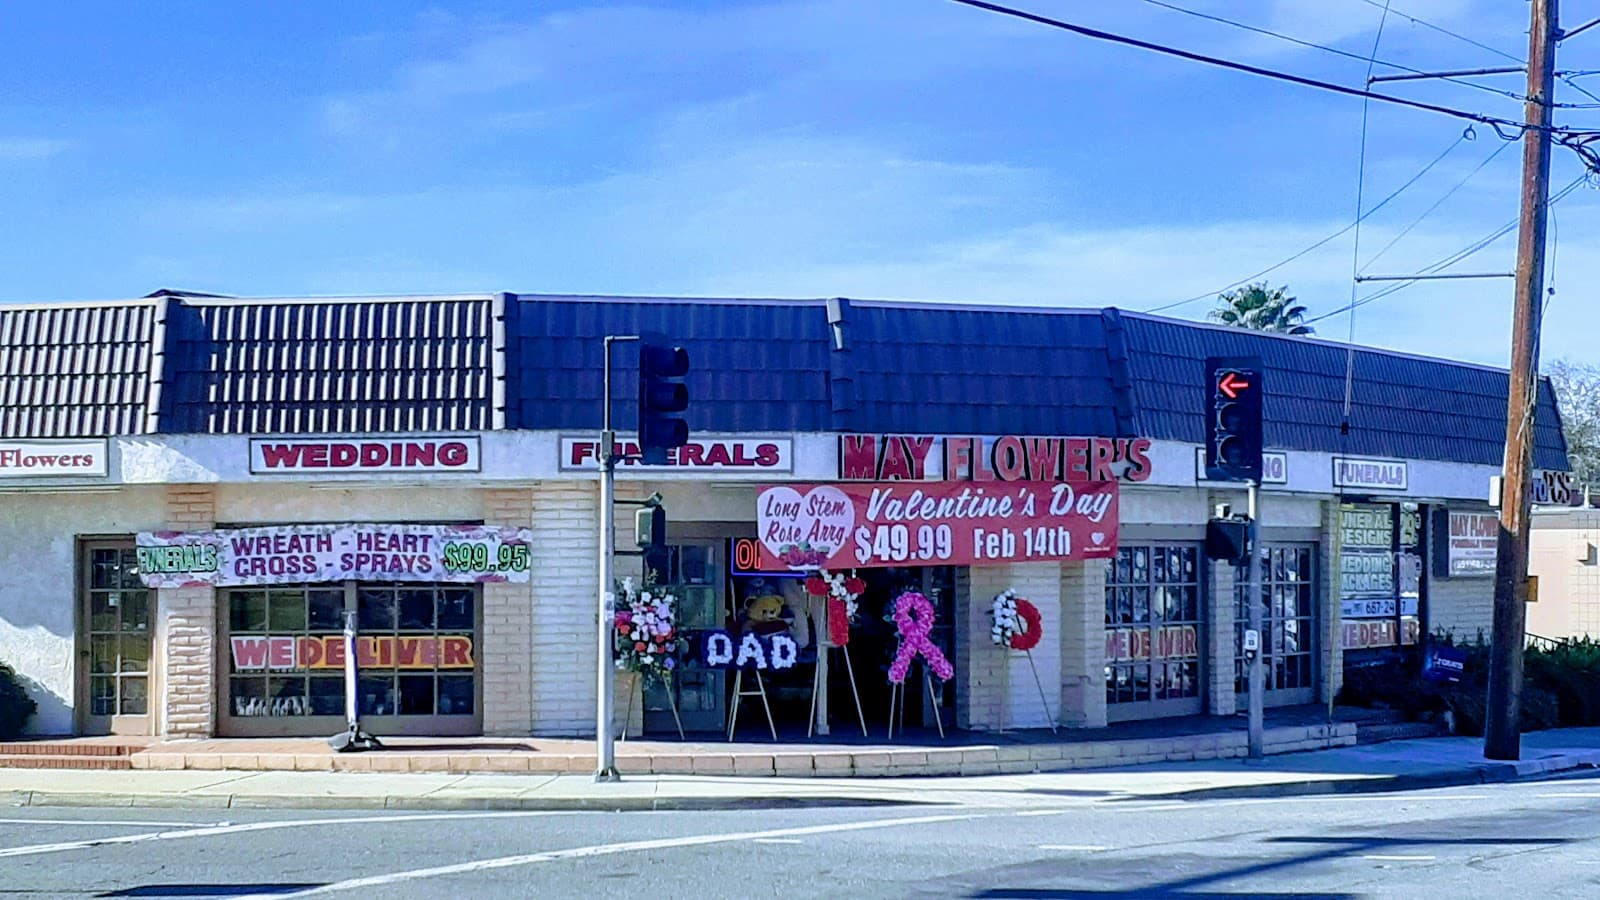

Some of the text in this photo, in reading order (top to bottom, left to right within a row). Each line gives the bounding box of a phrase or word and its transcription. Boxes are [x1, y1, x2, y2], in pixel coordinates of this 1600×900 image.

[0, 448, 93, 468] Flowers
[261, 442, 468, 467] WEDDING
[838, 436, 934, 480] MAY
[943, 436, 1152, 482] FLOWER'S
[1338, 462, 1403, 486] FUNERALS
[765, 494, 846, 522] Long Stem
[866, 483, 1113, 523] Valentine's Day
[231, 534, 333, 557] WREATH
[357, 533, 433, 553] HEART
[765, 520, 801, 543] Rose
[854, 524, 1071, 564] $49.99 Feb 14th
[137, 544, 218, 574] FUNERALS
[234, 555, 317, 577] CROSS
[340, 553, 433, 573] SPRAYS
[444, 541, 527, 572] $99.95
[232, 637, 474, 669] WE DELIVER
[707, 633, 797, 669] DAD
